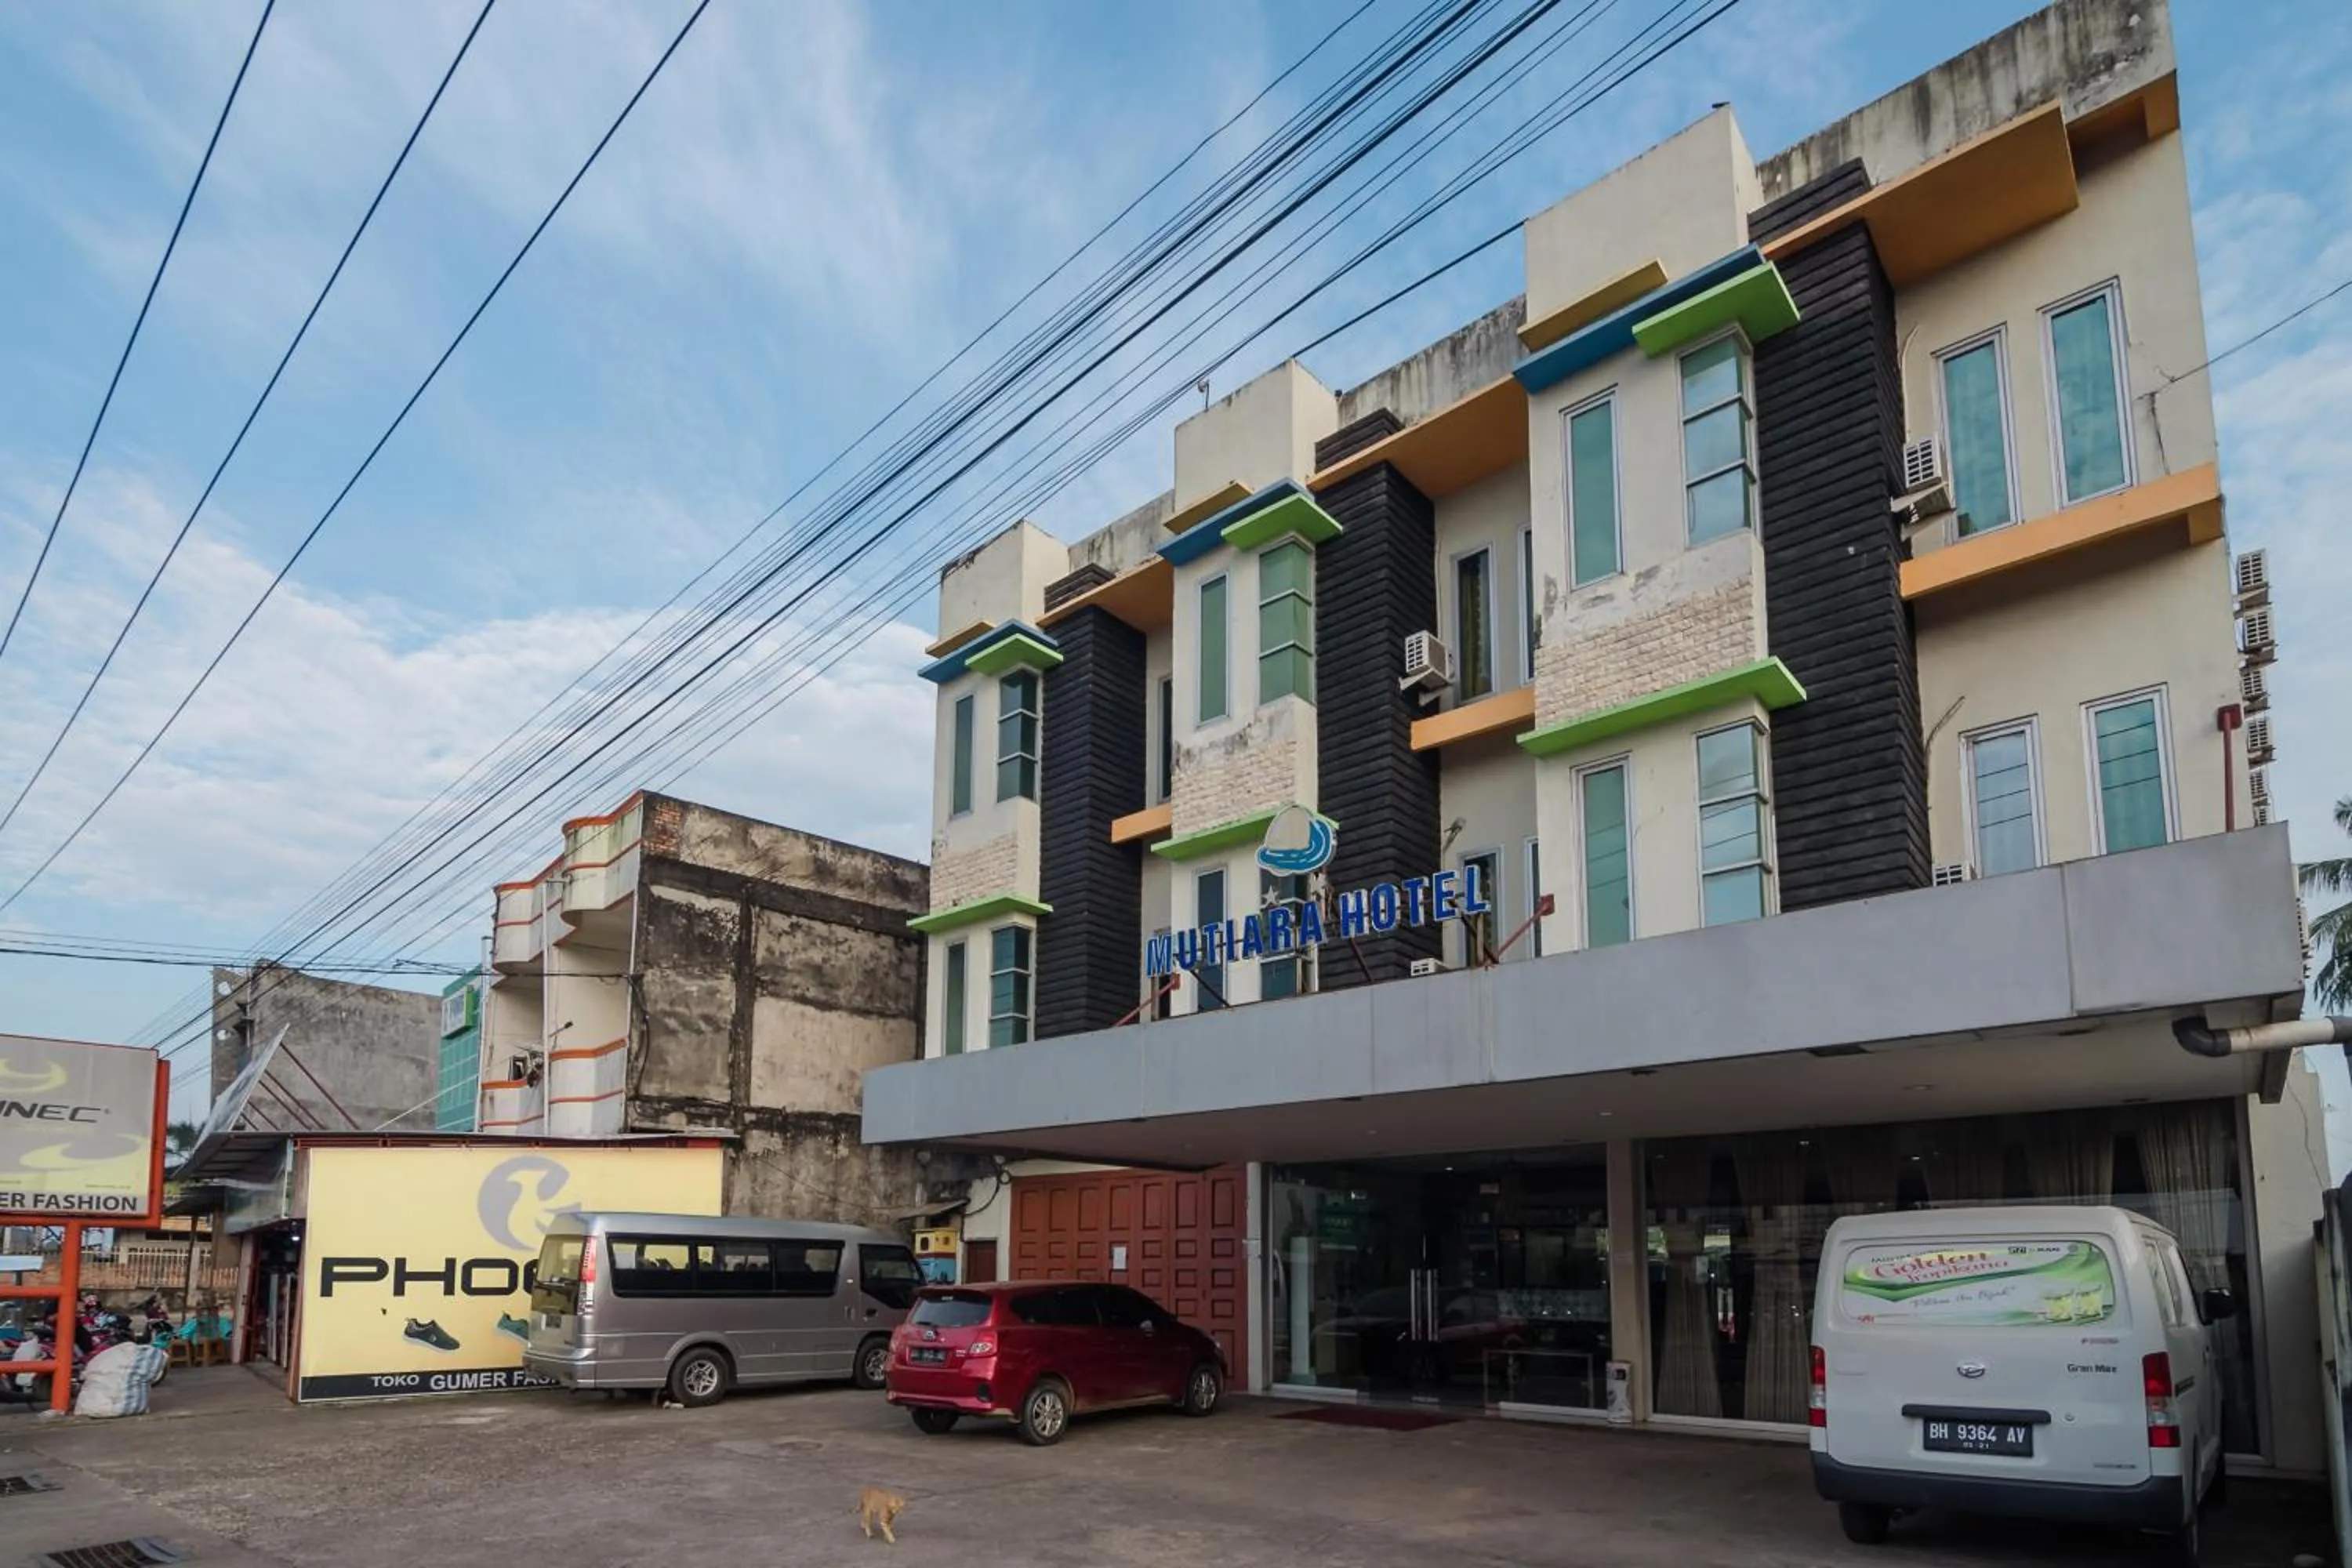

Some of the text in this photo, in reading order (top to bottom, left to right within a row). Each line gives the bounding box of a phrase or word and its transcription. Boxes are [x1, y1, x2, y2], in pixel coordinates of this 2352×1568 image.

[1146, 865, 1490, 978] MUTIARA HOTEL
[33, 1194, 137, 1211] FASHION
[371, 1374, 419, 1387] TOKO
[431, 1372, 506, 1390] GUMER
[1929, 1423, 2025, 1443] BH 9364 AV
